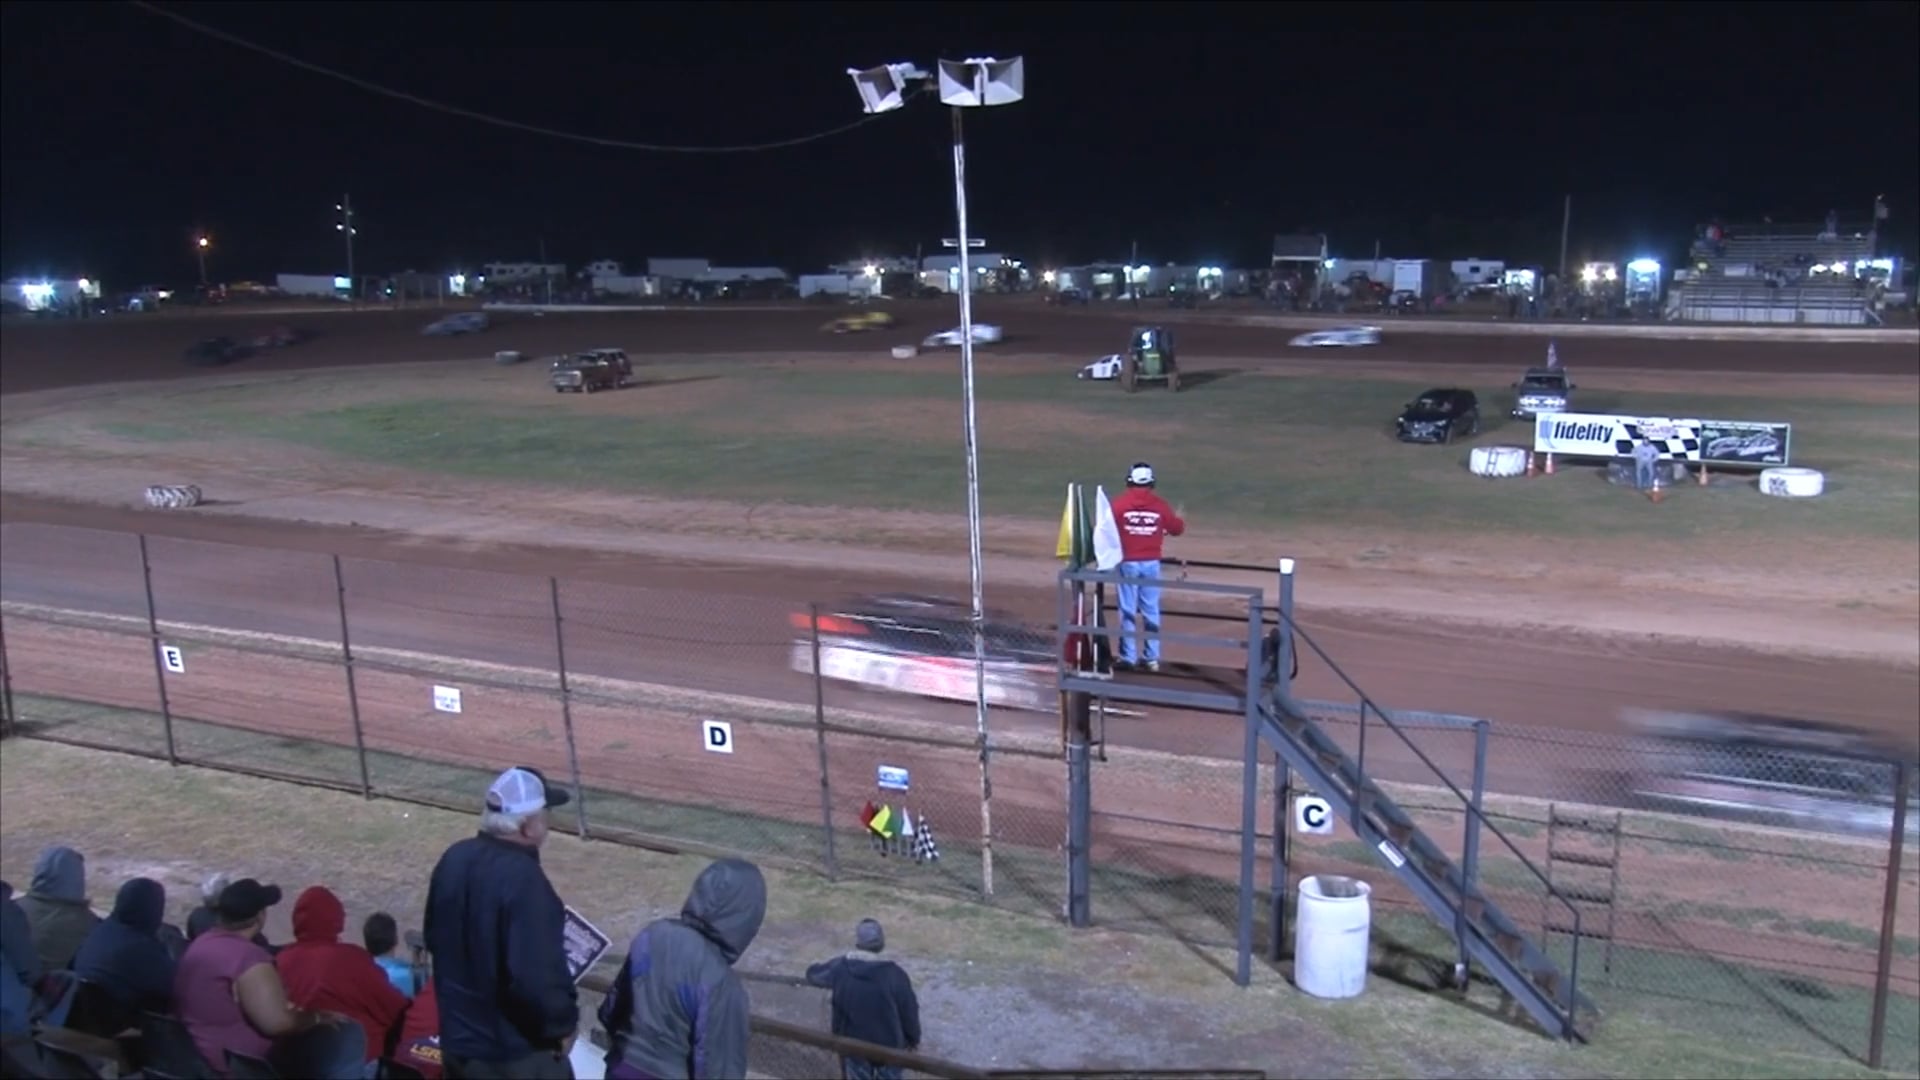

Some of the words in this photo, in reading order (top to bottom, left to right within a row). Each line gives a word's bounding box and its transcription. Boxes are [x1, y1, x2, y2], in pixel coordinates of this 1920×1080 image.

[1554, 421, 1613, 443] fidelity
[167, 650, 180, 667] E
[710, 726, 726, 746] D
[1303, 804, 1325, 827] C
